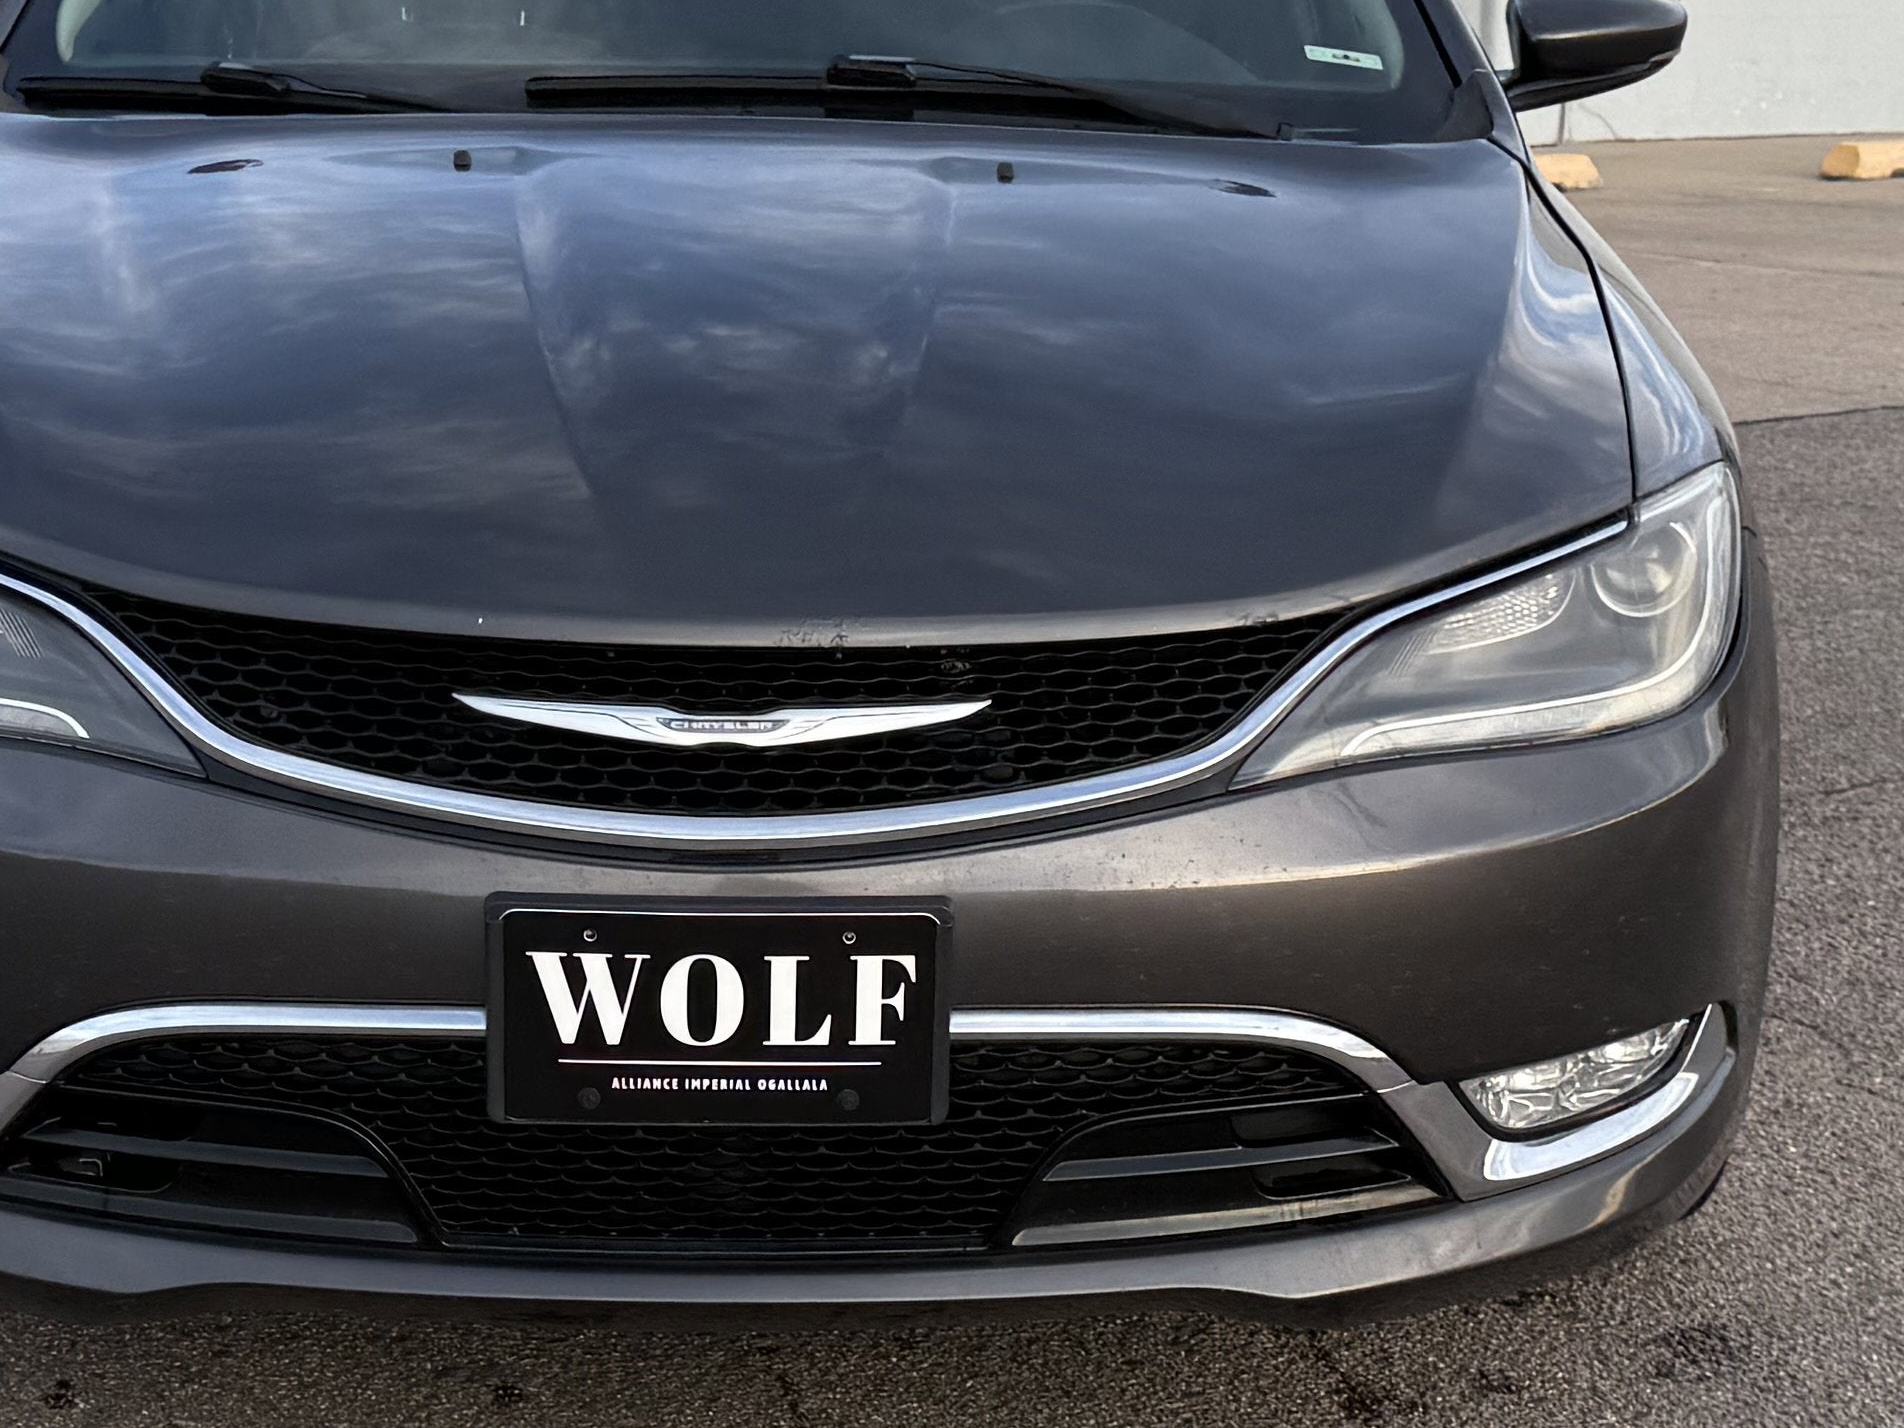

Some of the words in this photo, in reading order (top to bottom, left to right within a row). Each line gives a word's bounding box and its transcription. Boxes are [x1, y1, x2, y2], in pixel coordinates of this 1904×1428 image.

[525, 951, 917, 1047] WOLF
[611, 1076, 679, 1090] ALLIANCE
[685, 1077, 751, 1091] IMPERIAL
[757, 1078, 828, 1092] OGALLALA
